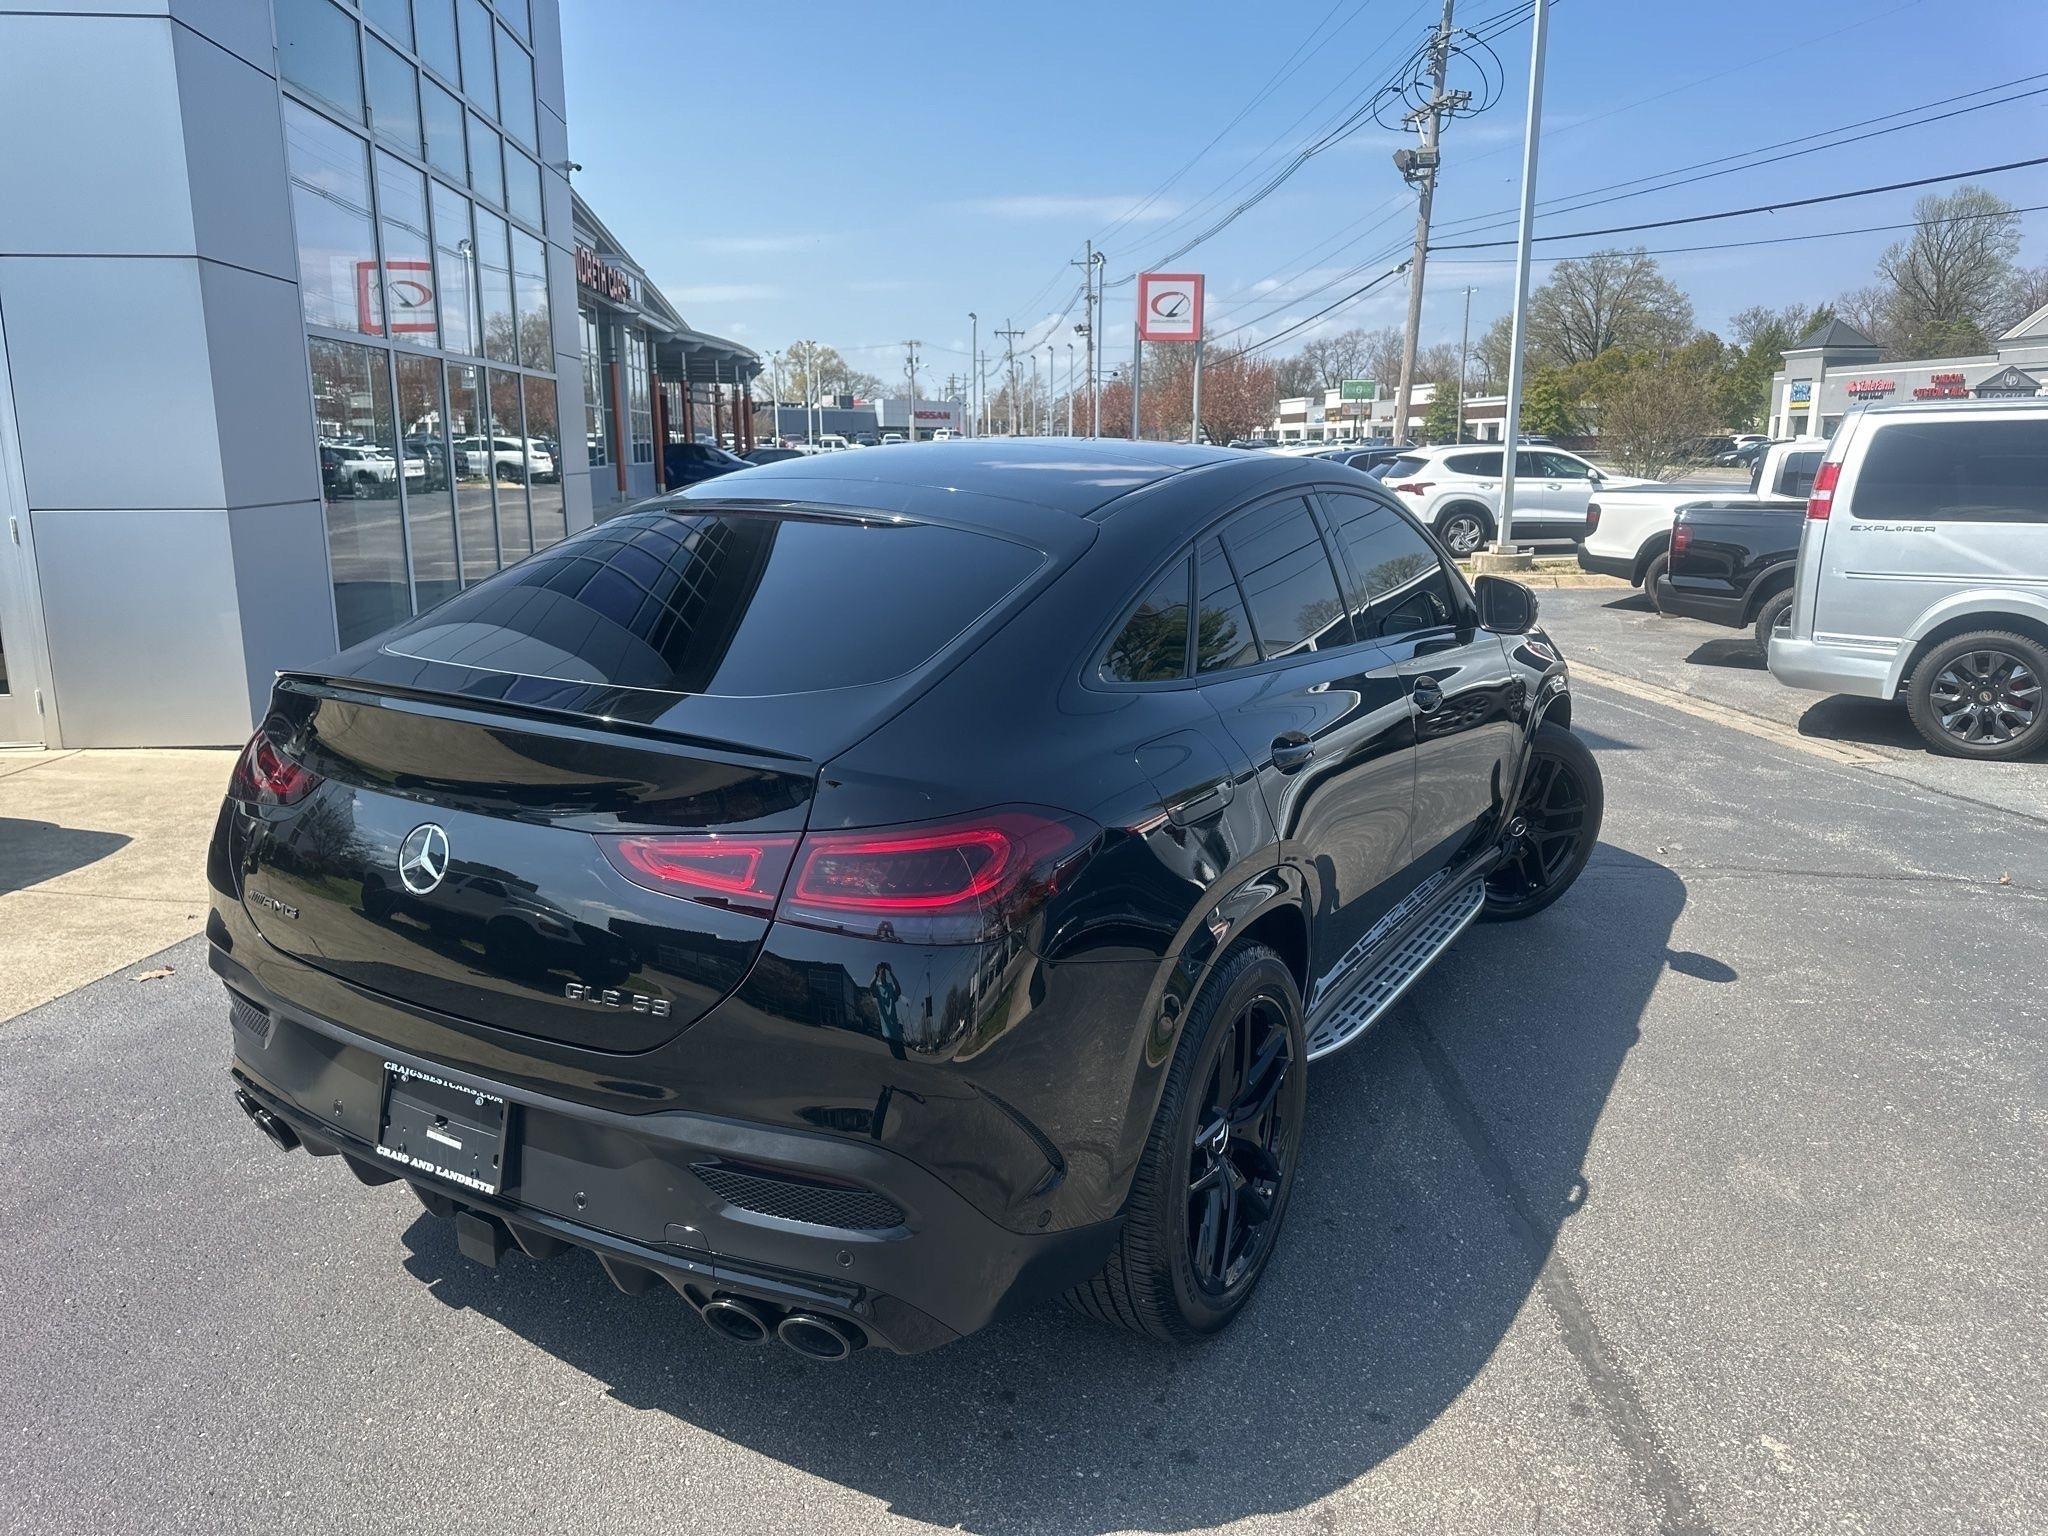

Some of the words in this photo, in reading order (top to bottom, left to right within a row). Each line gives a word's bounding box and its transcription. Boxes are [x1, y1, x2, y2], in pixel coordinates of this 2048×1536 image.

[914, 411, 951, 420] NISSAN
[1849, 525, 1937, 533] EXPLORER
[565, 983, 621, 1008] GLE
[632, 994, 672, 1017] 53
[376, 1144, 410, 1164] CRAIG
[410, 1157, 435, 1173] AND
[434, 1165, 496, 1195] LANDRETH
